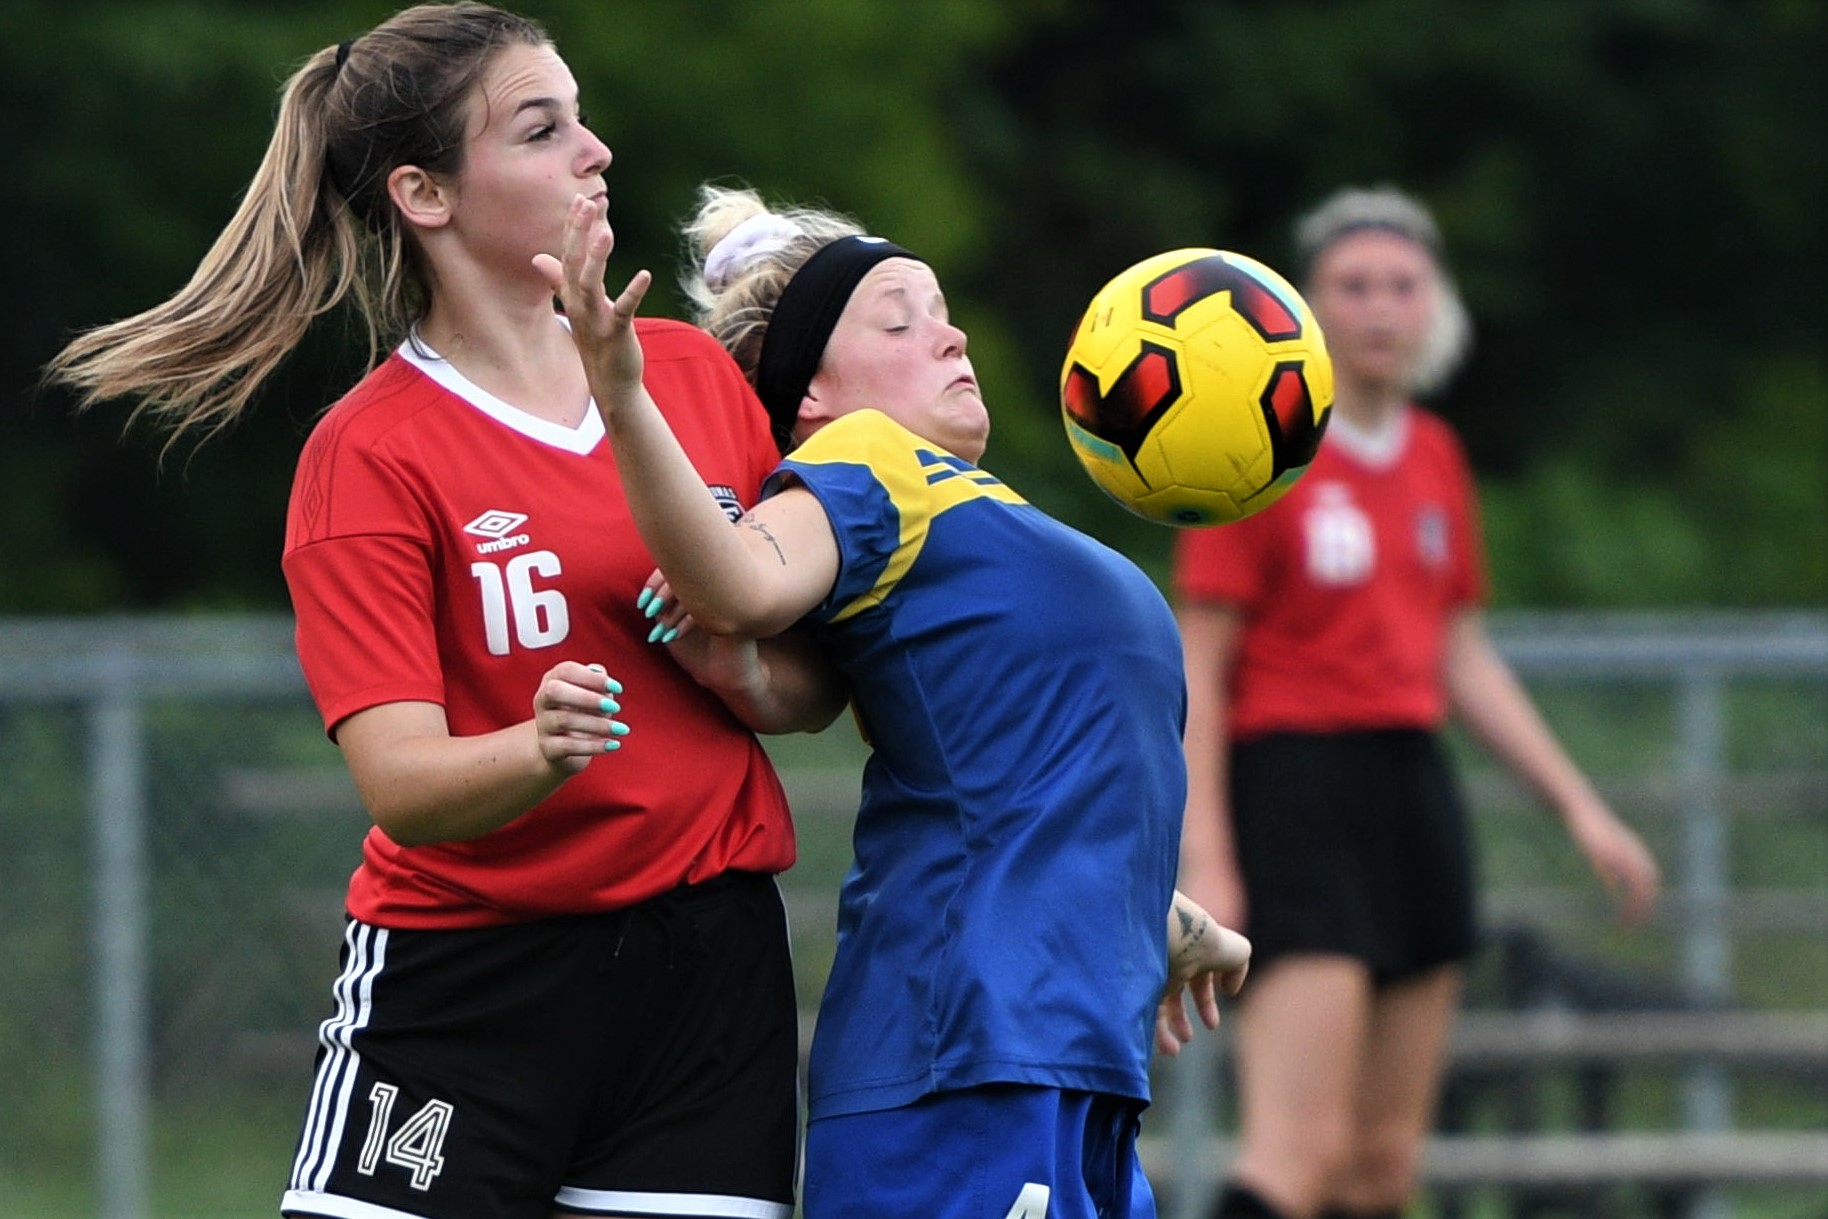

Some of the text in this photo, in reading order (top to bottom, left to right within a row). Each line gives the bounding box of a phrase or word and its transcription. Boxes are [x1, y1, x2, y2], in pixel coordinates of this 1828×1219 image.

[477, 533, 530, 554] umbro
[471, 550, 570, 655] 16
[357, 1081, 454, 1191] 14
